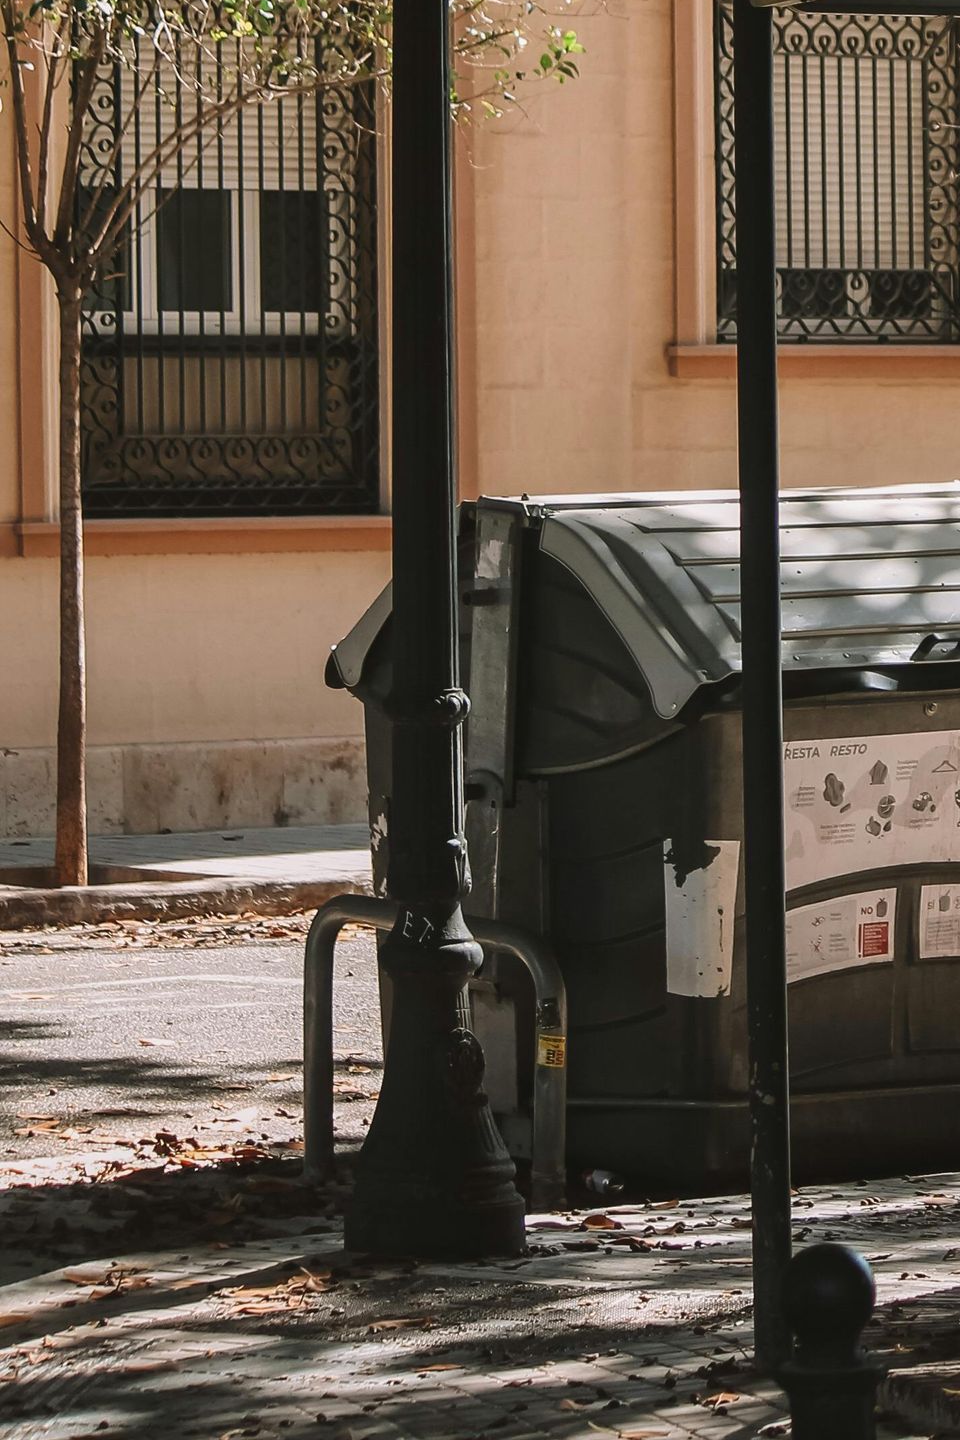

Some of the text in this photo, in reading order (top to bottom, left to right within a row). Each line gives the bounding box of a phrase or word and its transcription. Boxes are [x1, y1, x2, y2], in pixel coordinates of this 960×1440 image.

[784, 744, 867, 760] RESTA RESTO
[860, 906, 874, 916] NO
